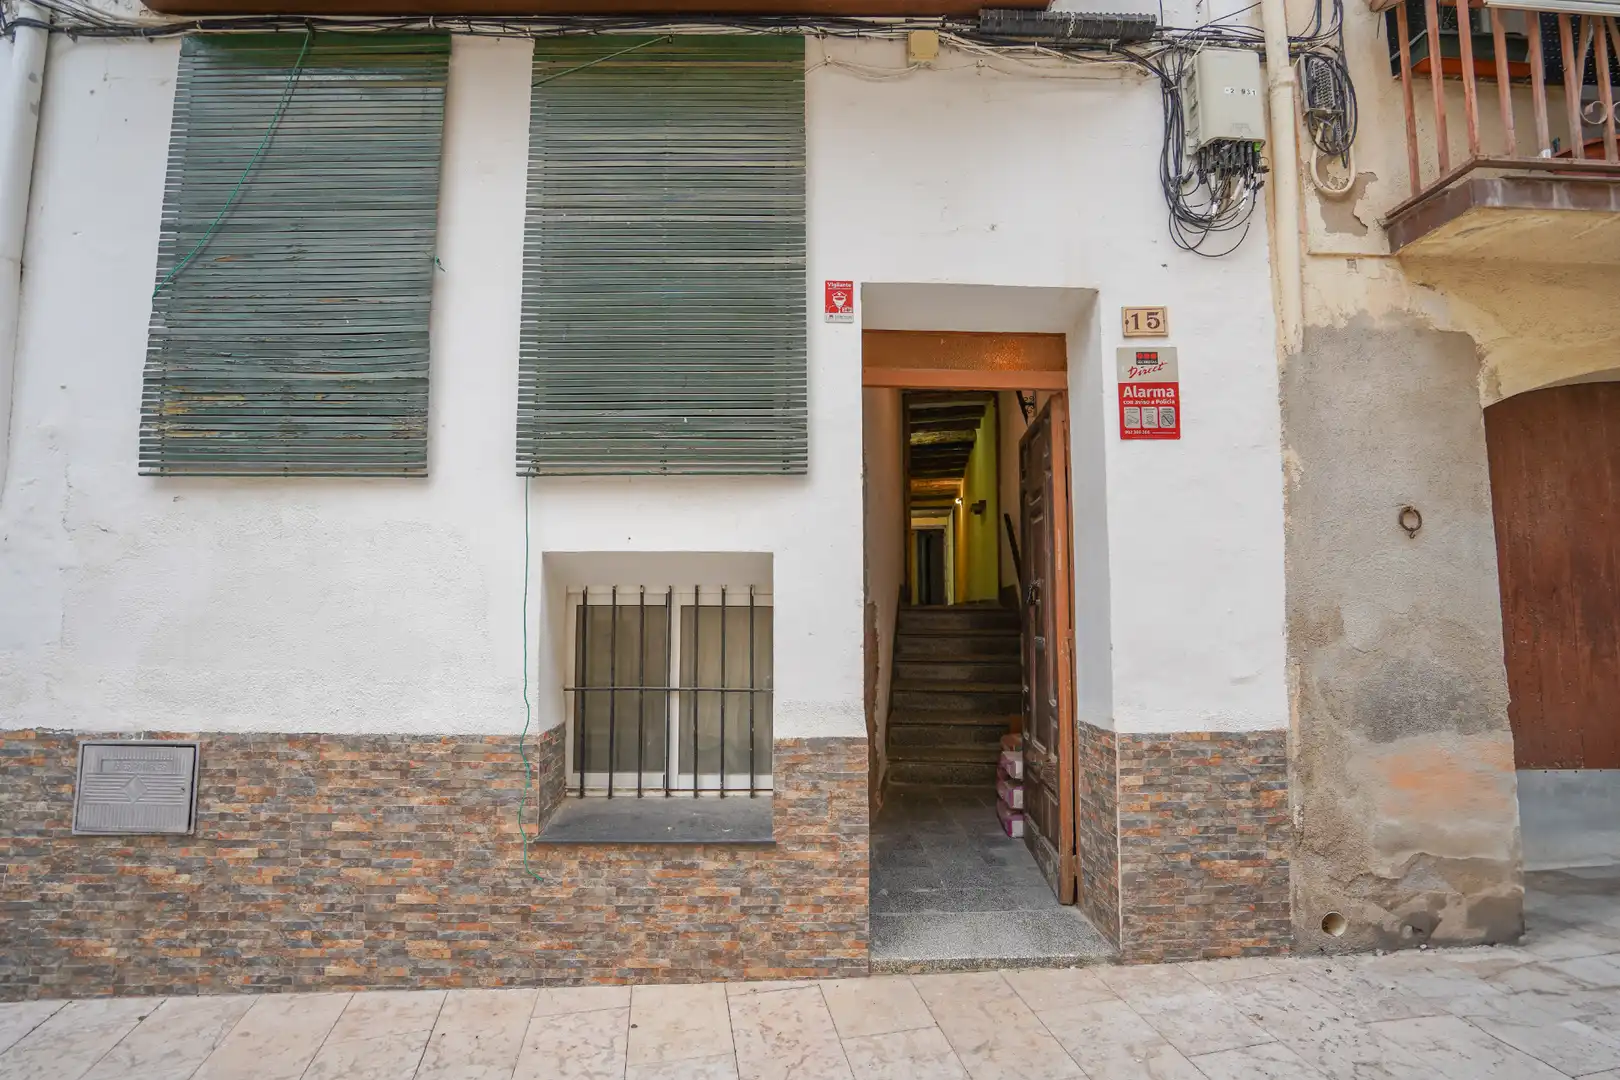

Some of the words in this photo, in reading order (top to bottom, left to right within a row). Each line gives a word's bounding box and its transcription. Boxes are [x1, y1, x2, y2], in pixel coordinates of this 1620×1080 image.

[1131, 311, 1160, 330] 15
[1127, 360, 1168, 379] Direct
[1123, 385, 1175, 398] Alarma
